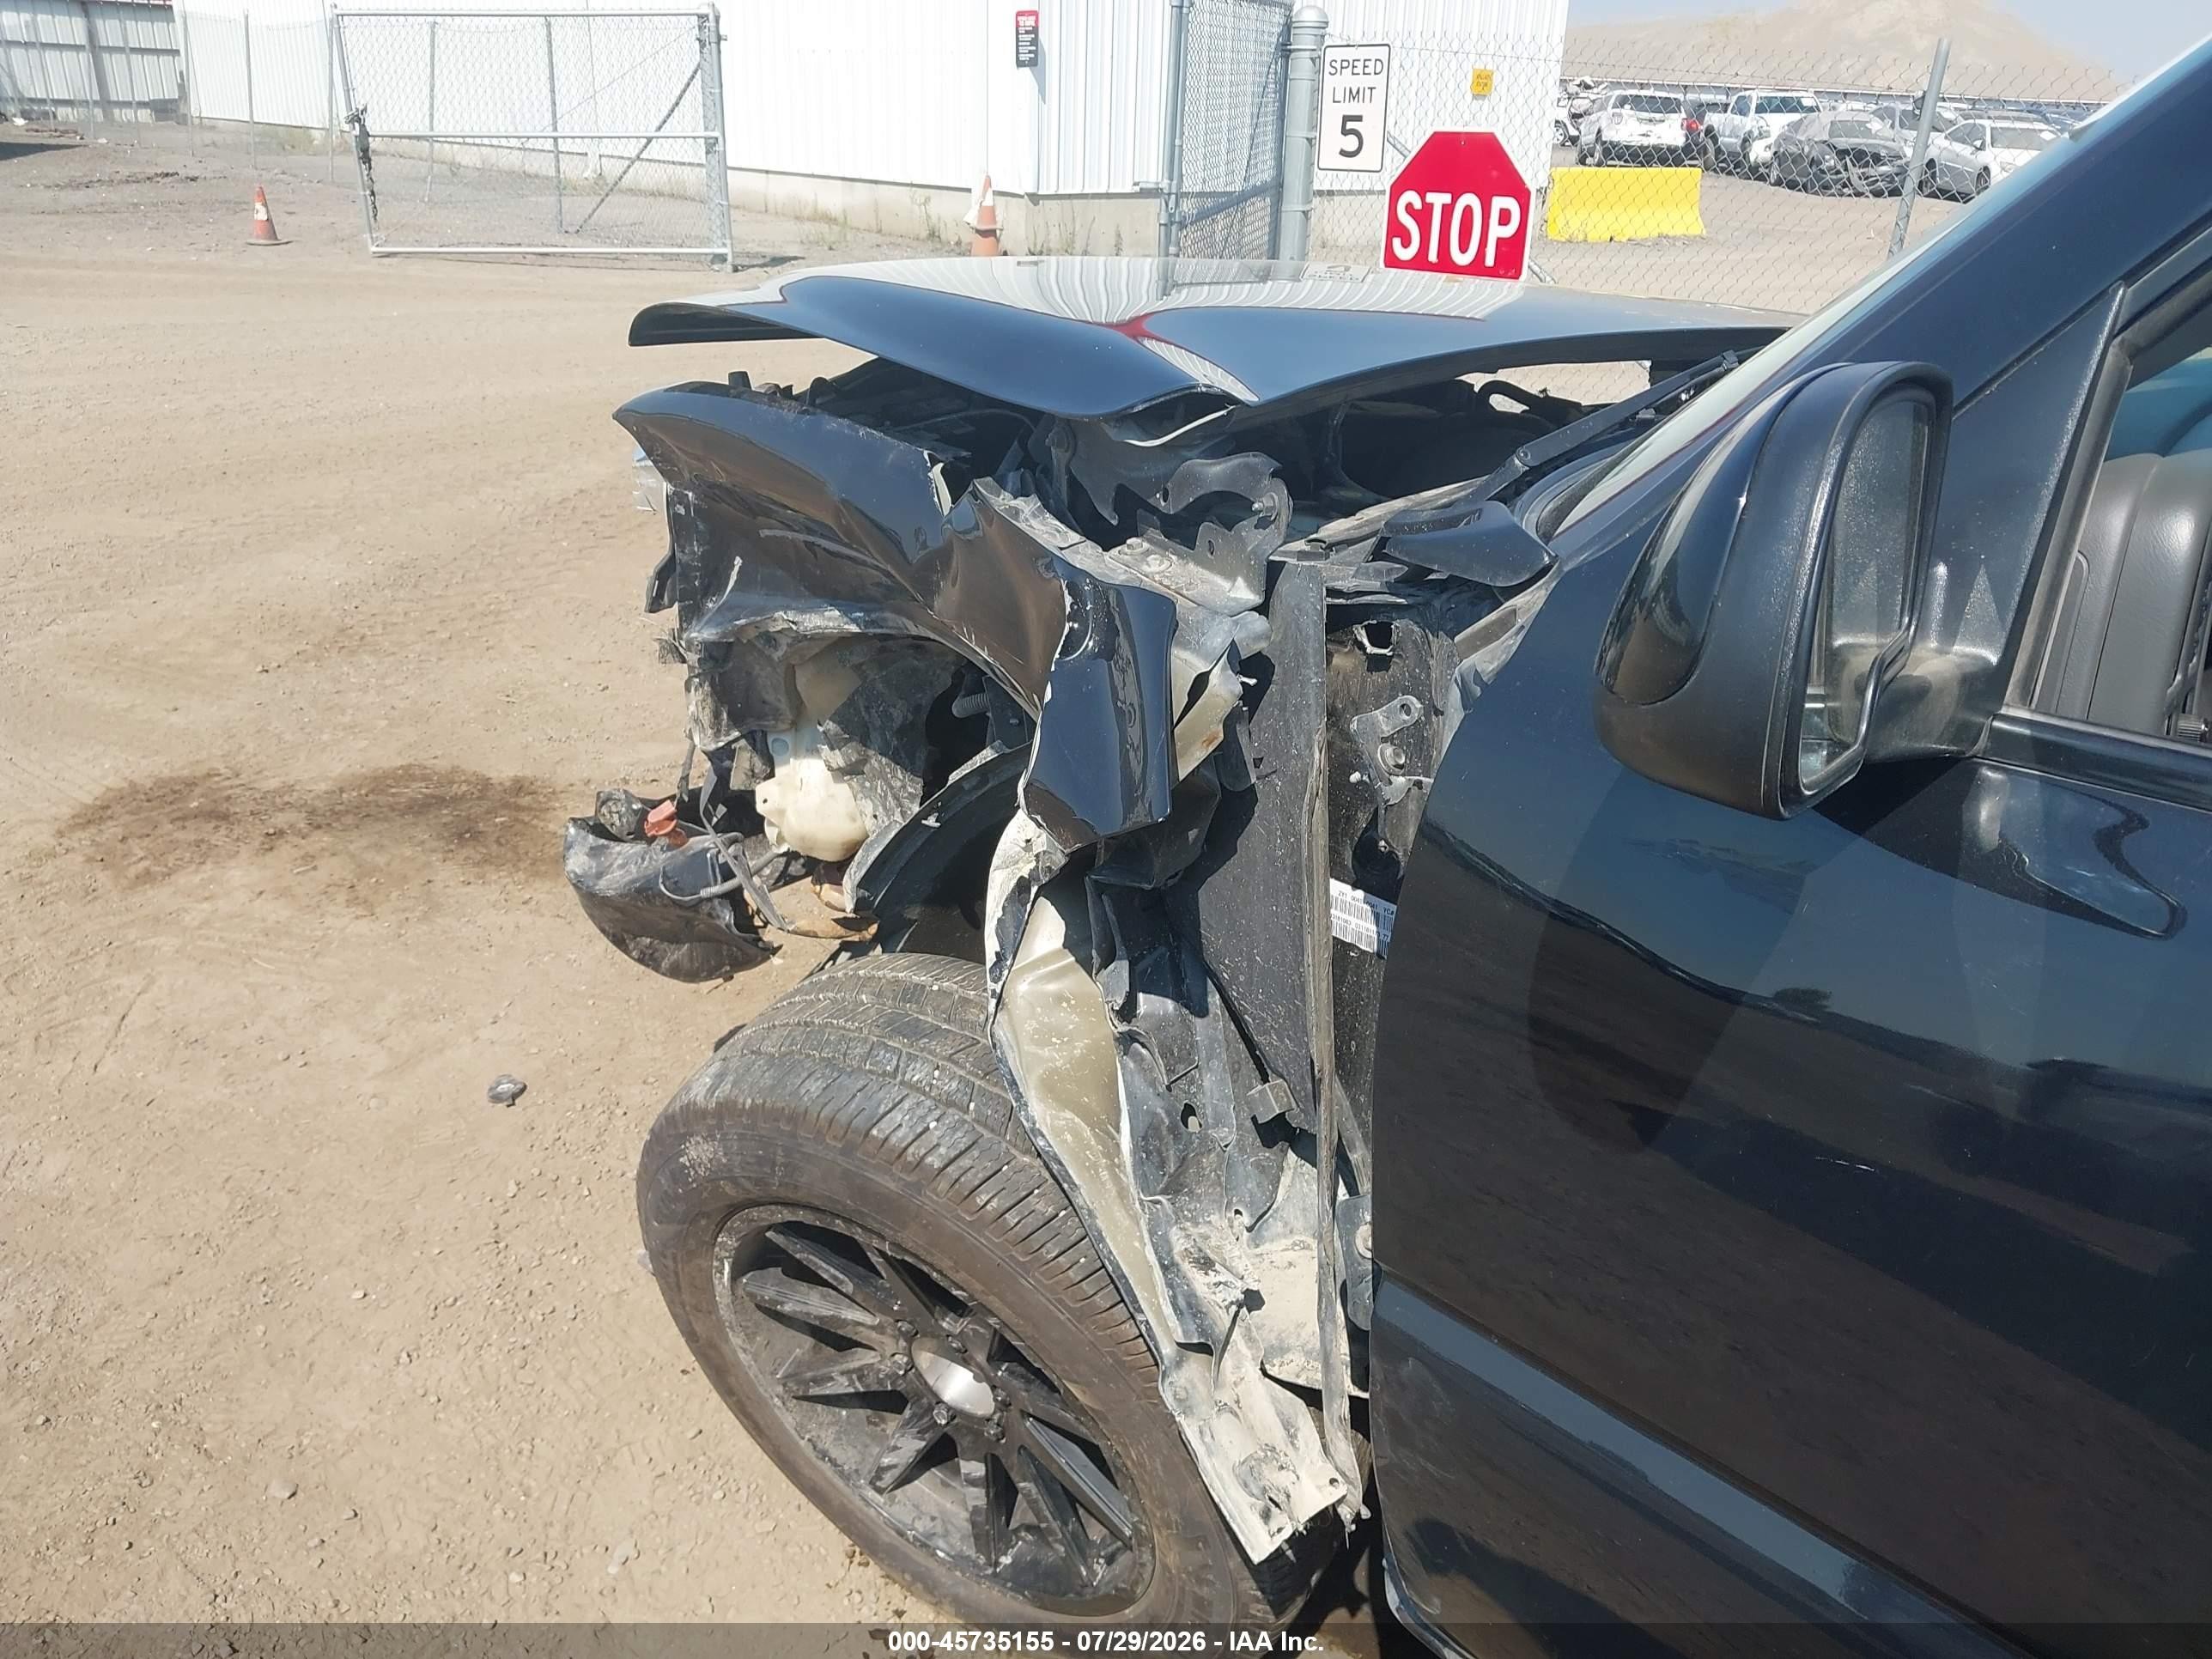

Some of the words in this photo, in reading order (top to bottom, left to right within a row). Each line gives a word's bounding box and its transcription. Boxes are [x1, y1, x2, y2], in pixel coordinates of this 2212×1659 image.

[1328, 58, 1384, 76] SPEED
[1332, 87, 1376, 104] LIMIT
[1339, 114, 1364, 158] 5
[1392, 190, 1521, 267] STOP
